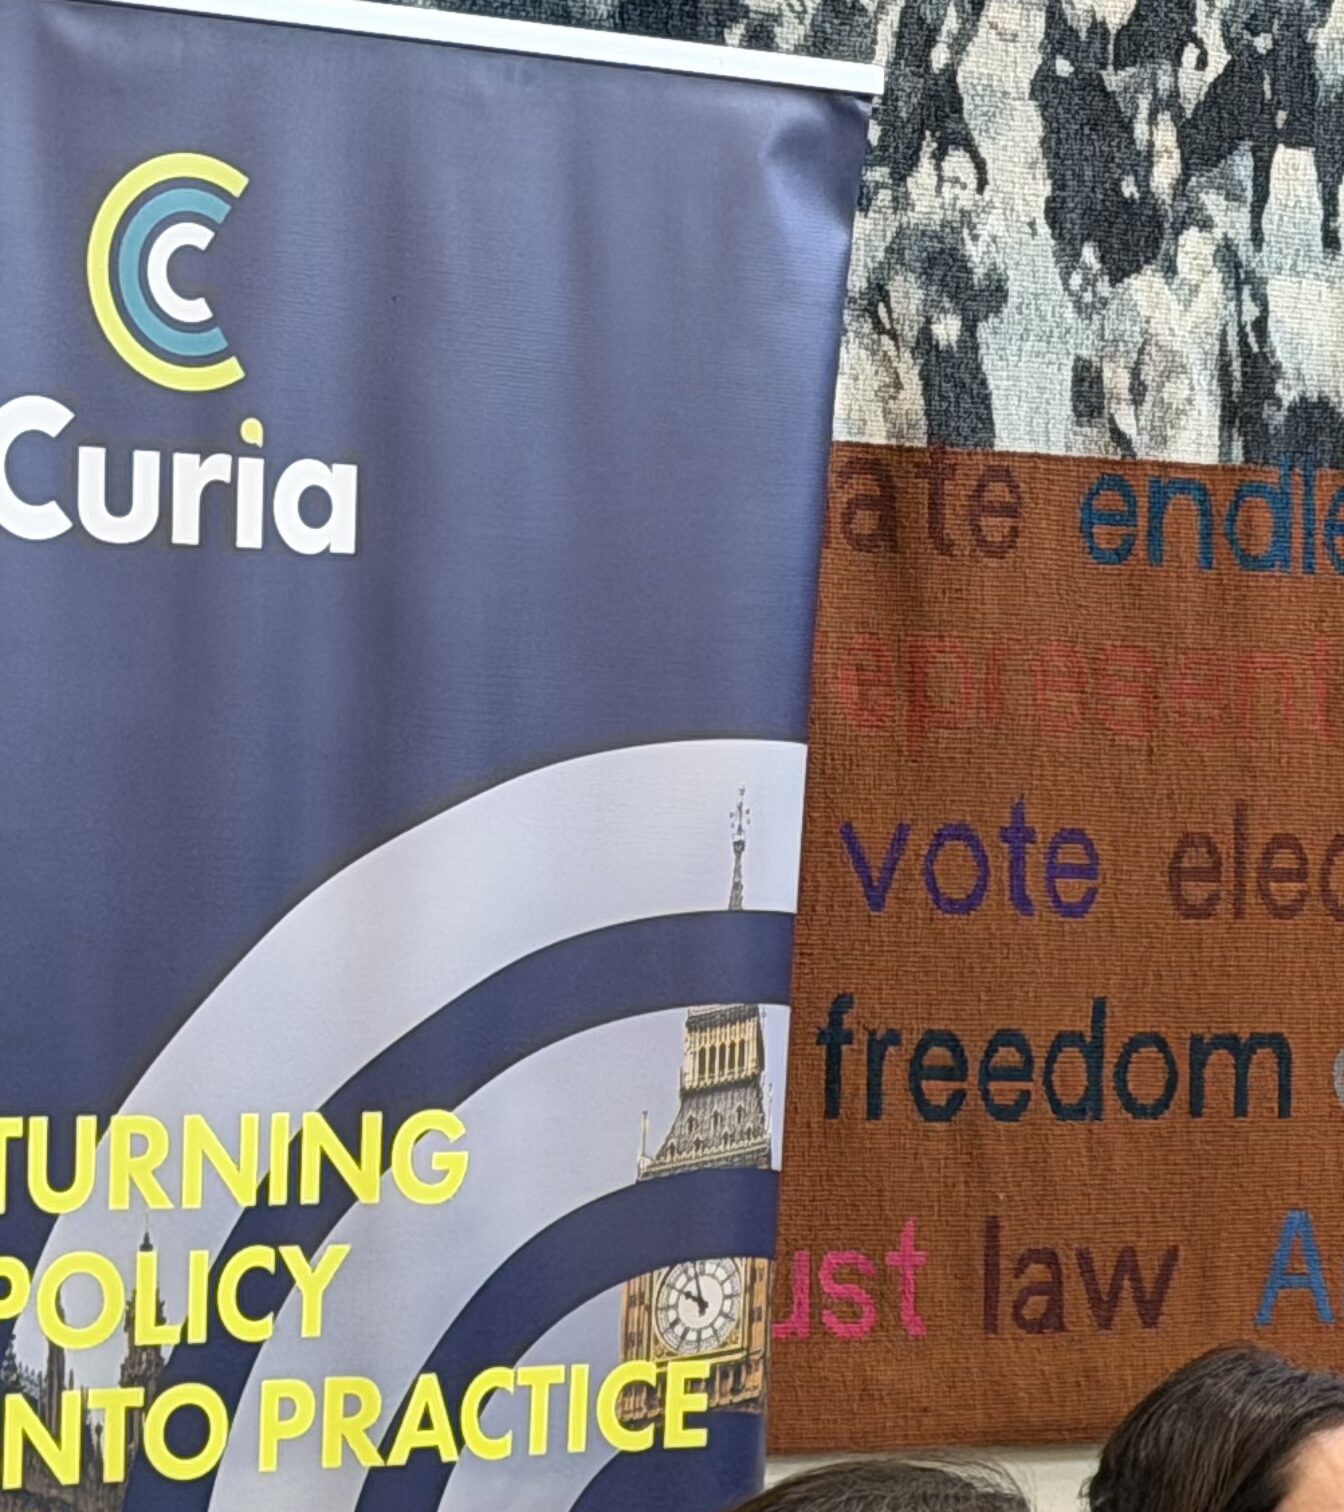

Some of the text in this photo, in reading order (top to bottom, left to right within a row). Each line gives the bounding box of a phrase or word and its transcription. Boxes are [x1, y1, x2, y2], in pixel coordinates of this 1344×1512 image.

[0, 395, 358, 556] Curia
[841, 801, 1100, 918] vote
[815, 994, 1294, 1122] freedom
[982, 1217, 1180, 1335] law
[2, 1360, 711, 1491] NTO PRACTICE
